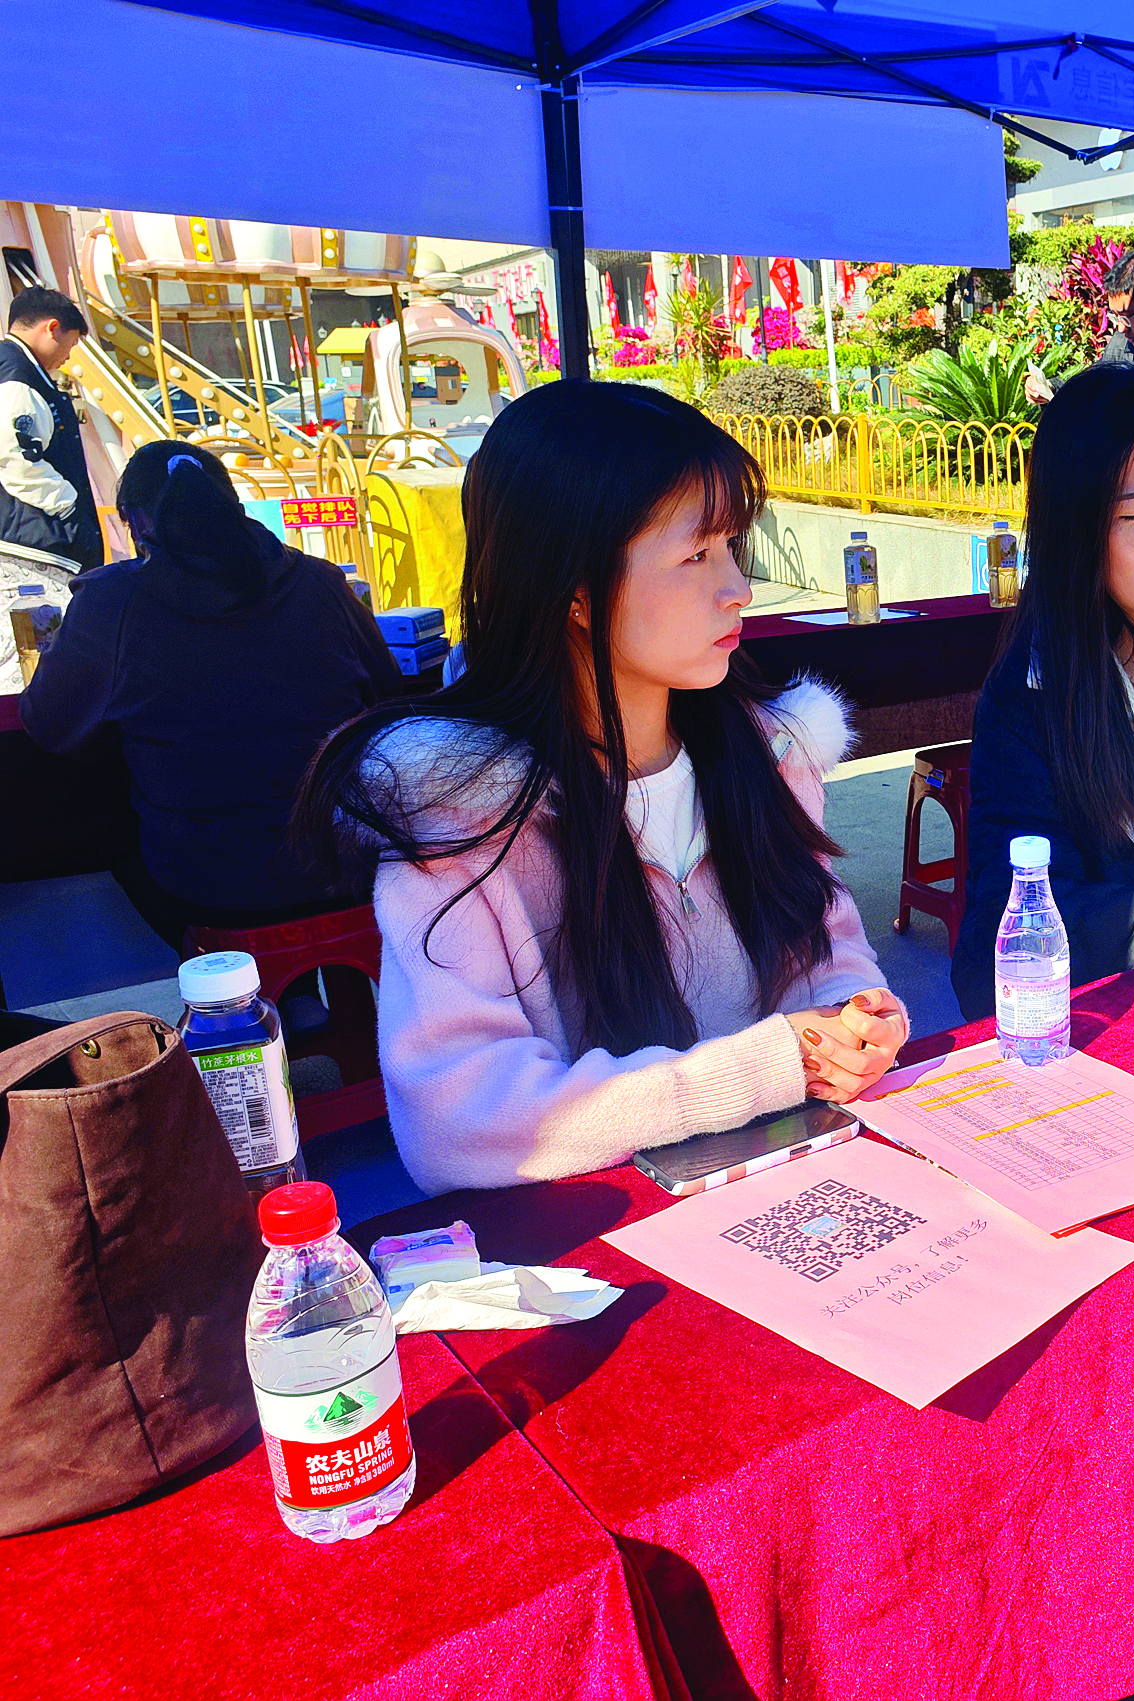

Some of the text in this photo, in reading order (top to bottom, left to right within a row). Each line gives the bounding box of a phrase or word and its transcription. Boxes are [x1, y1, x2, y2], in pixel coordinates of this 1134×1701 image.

[282, 501, 355, 514] 自觉排队
[284, 512, 356, 524] 先下后上
[201, 1051, 259, 1069] 竹蔗茅根水
[820, 1219, 988, 1319] 关注公众号，了解更多
[887, 1255, 969, 1306] 岗位信息！
[305, 1429, 391, 1474] 农夫山泉
[308, 1446, 393, 1486] NONGFU SPRING
[310, 1480, 352, 1496] 饮用天然水
